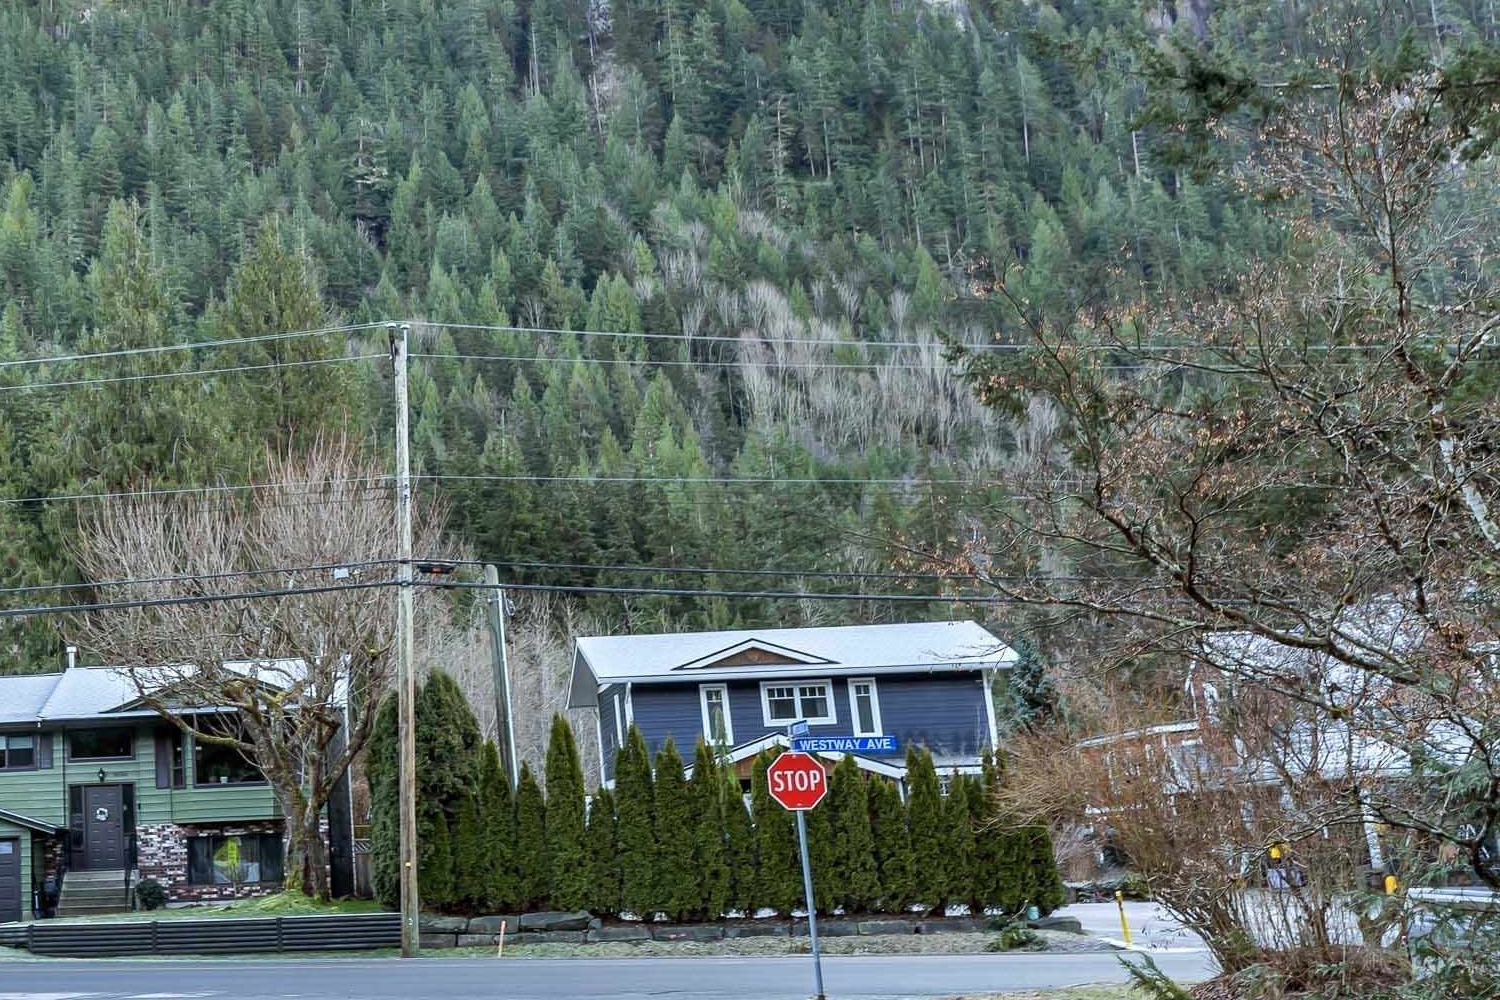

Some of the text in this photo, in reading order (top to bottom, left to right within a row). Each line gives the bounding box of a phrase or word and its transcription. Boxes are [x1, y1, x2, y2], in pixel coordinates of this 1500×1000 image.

[799, 738, 891, 751] WESTWAY AVE
[773, 769, 821, 792] STOP
